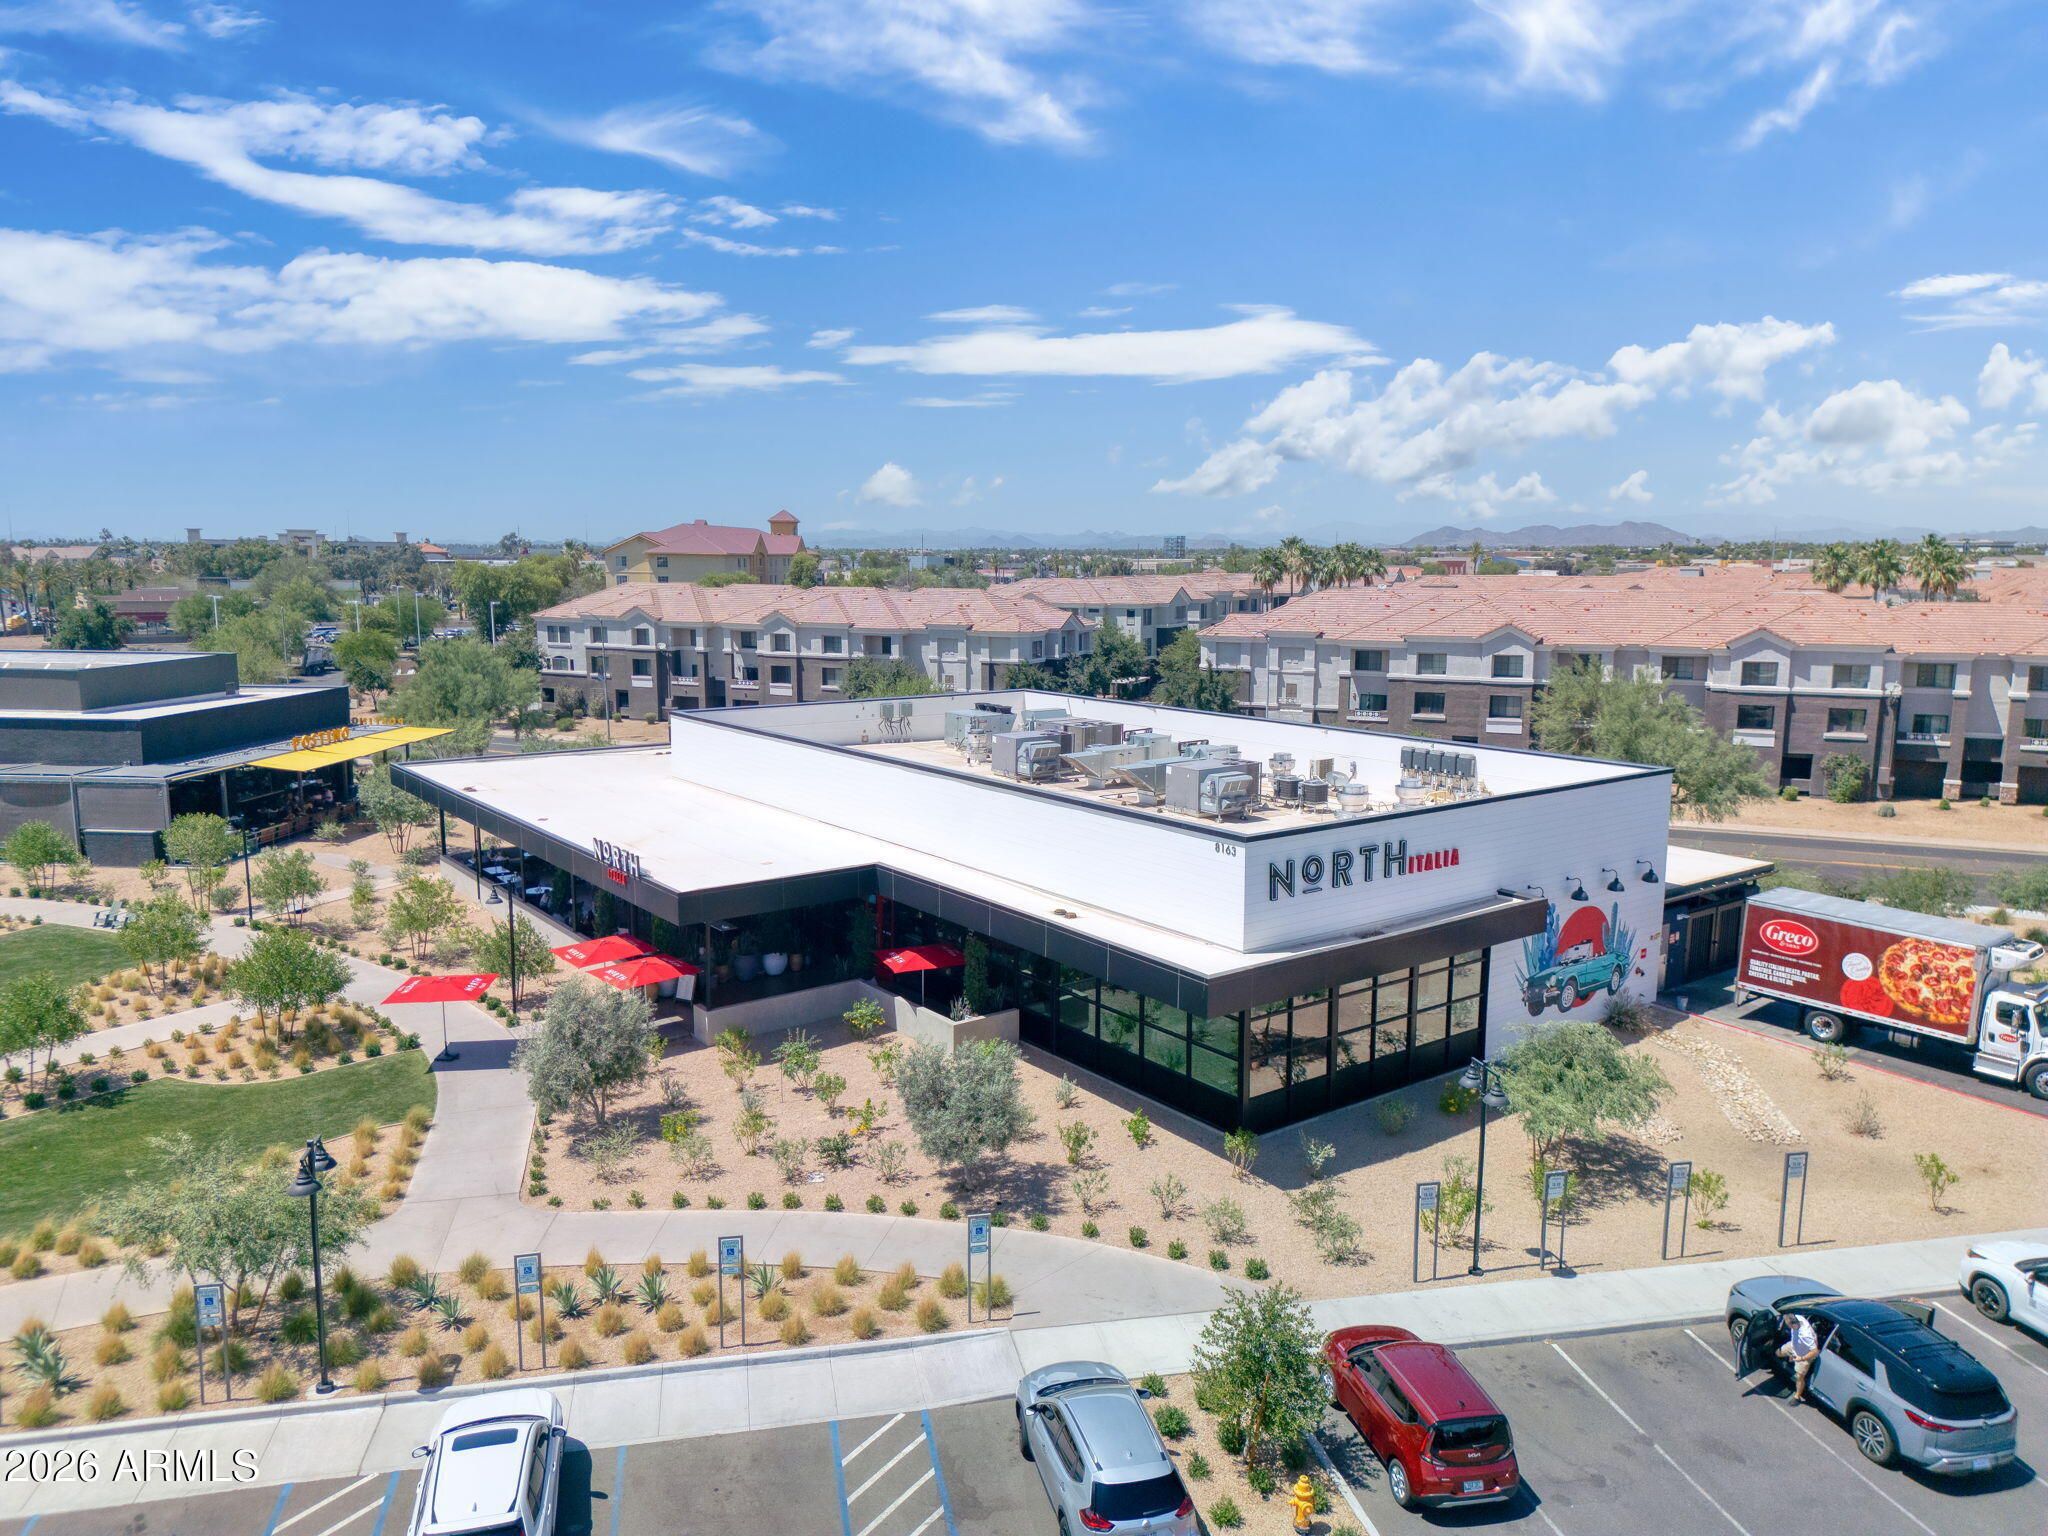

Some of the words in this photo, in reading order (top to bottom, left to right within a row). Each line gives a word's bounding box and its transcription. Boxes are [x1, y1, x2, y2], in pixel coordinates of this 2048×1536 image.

[292, 726, 349, 750] POSTINO
[593, 838, 640, 879] NORTH
[1215, 842, 1236, 857] 8163
[1269, 839, 1407, 901] NORTH
[1408, 848, 1459, 874] ITALIA
[1766, 925, 1813, 947] Greco
[605, 969, 628, 980] NORTH
[1750, 959, 1768, 968] QUALITY
